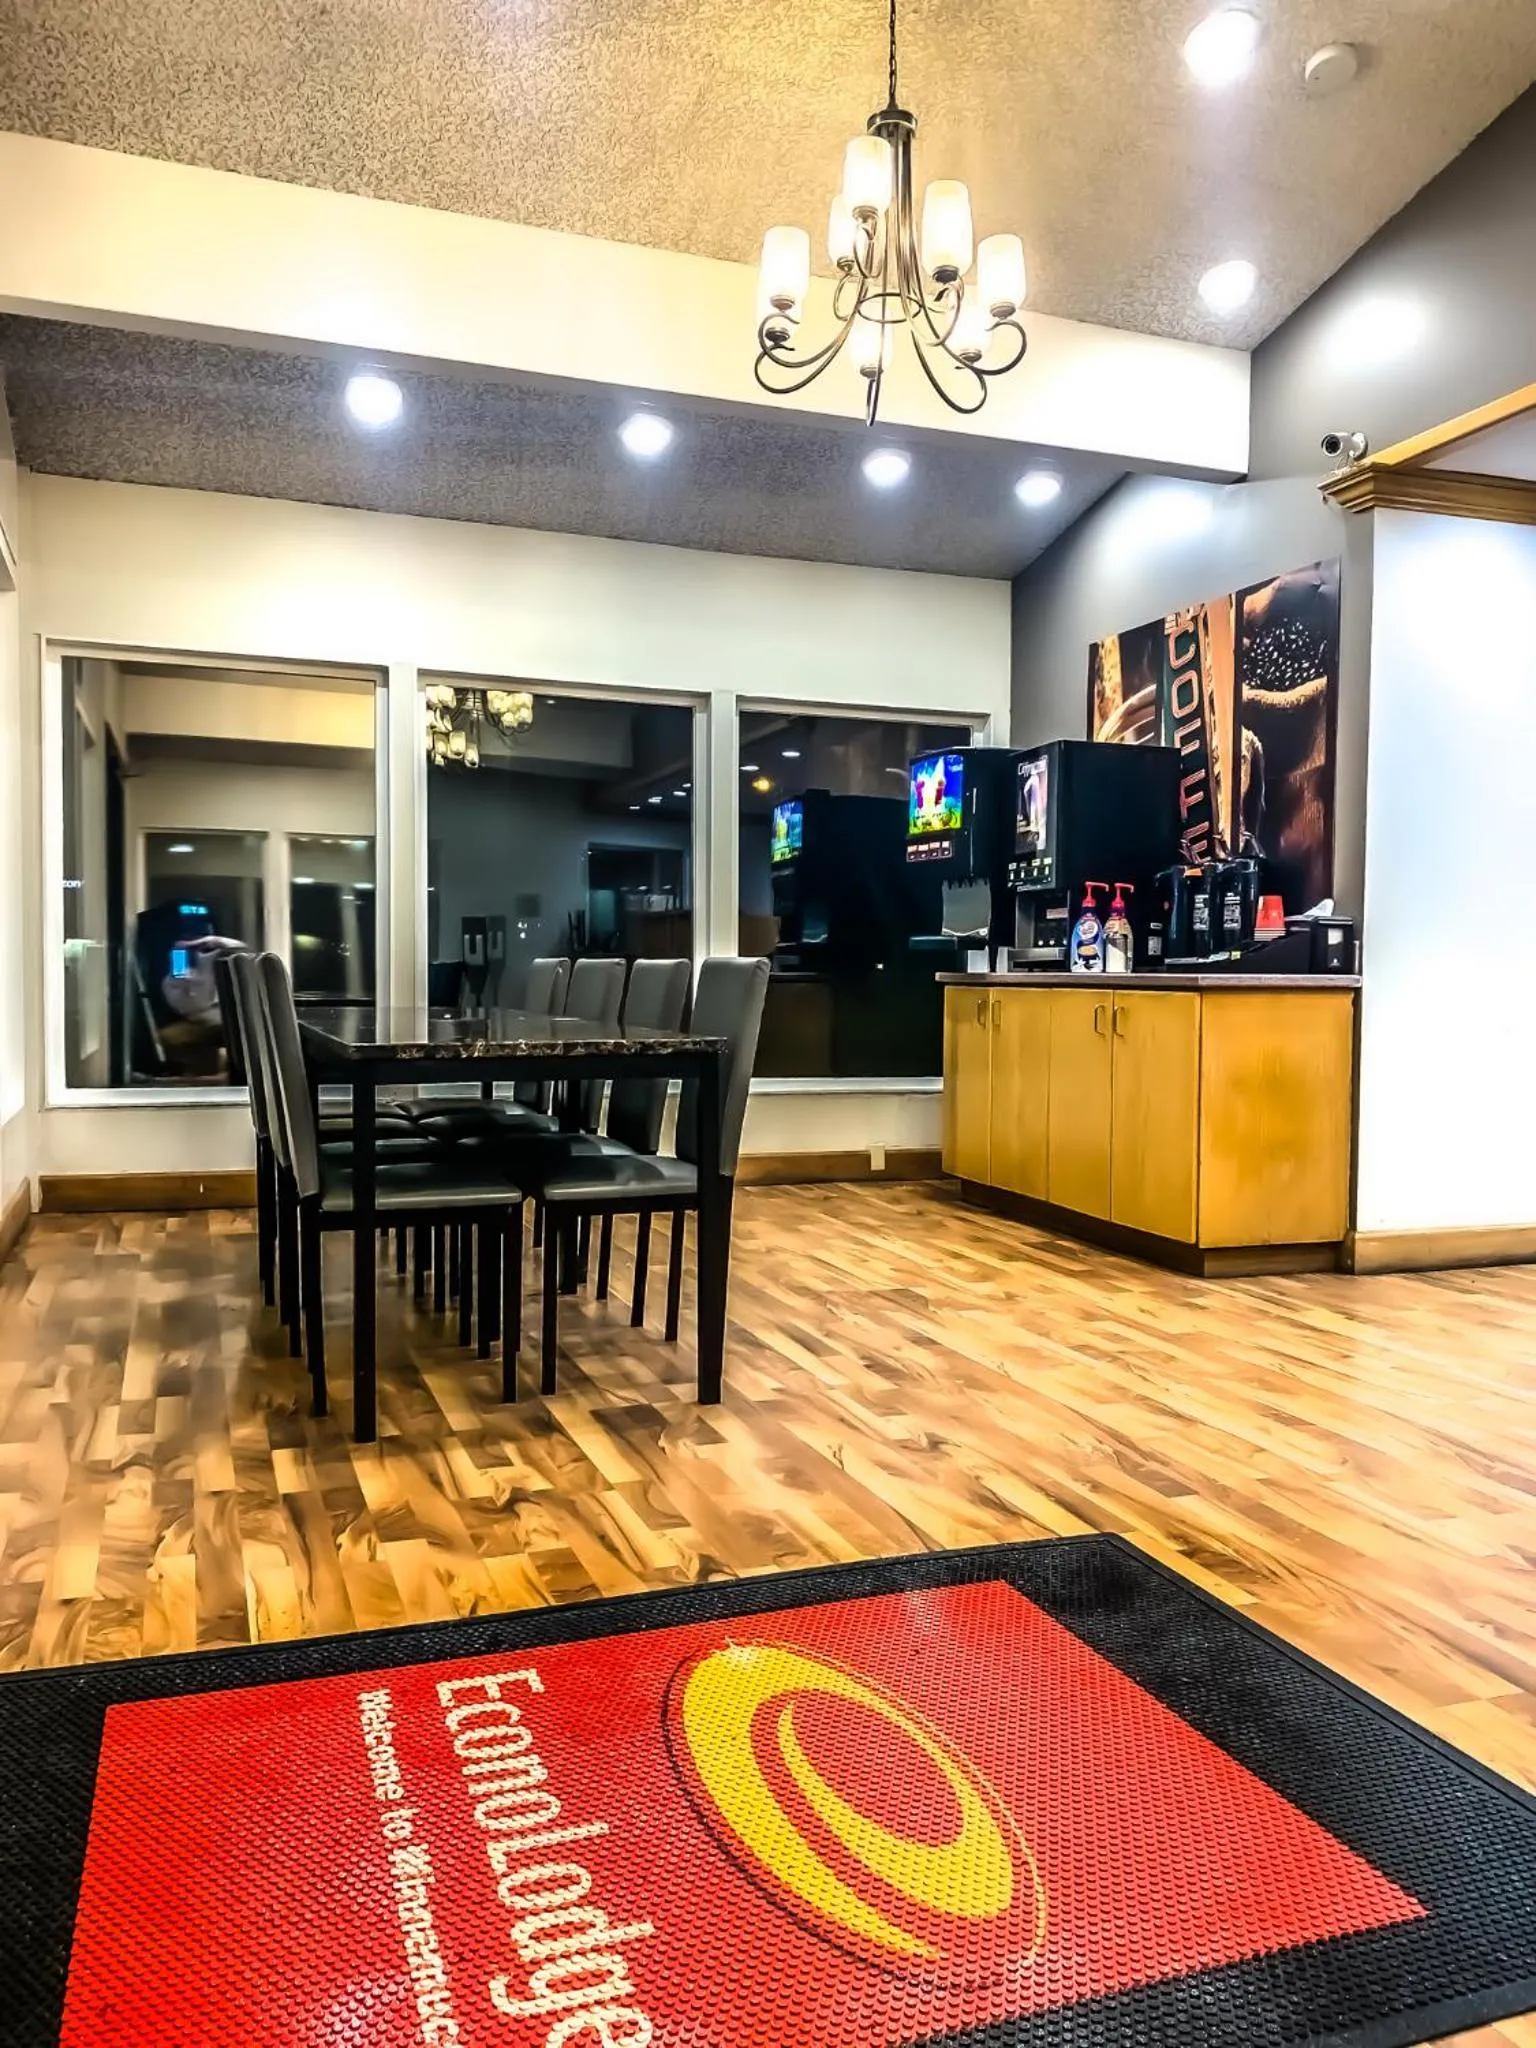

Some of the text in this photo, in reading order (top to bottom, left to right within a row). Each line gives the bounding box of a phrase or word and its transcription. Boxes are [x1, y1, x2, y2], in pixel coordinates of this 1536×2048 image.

[1169, 620, 1211, 863] COFFEE
[357, 1688, 464, 2048] Welcome to Winnemuc
